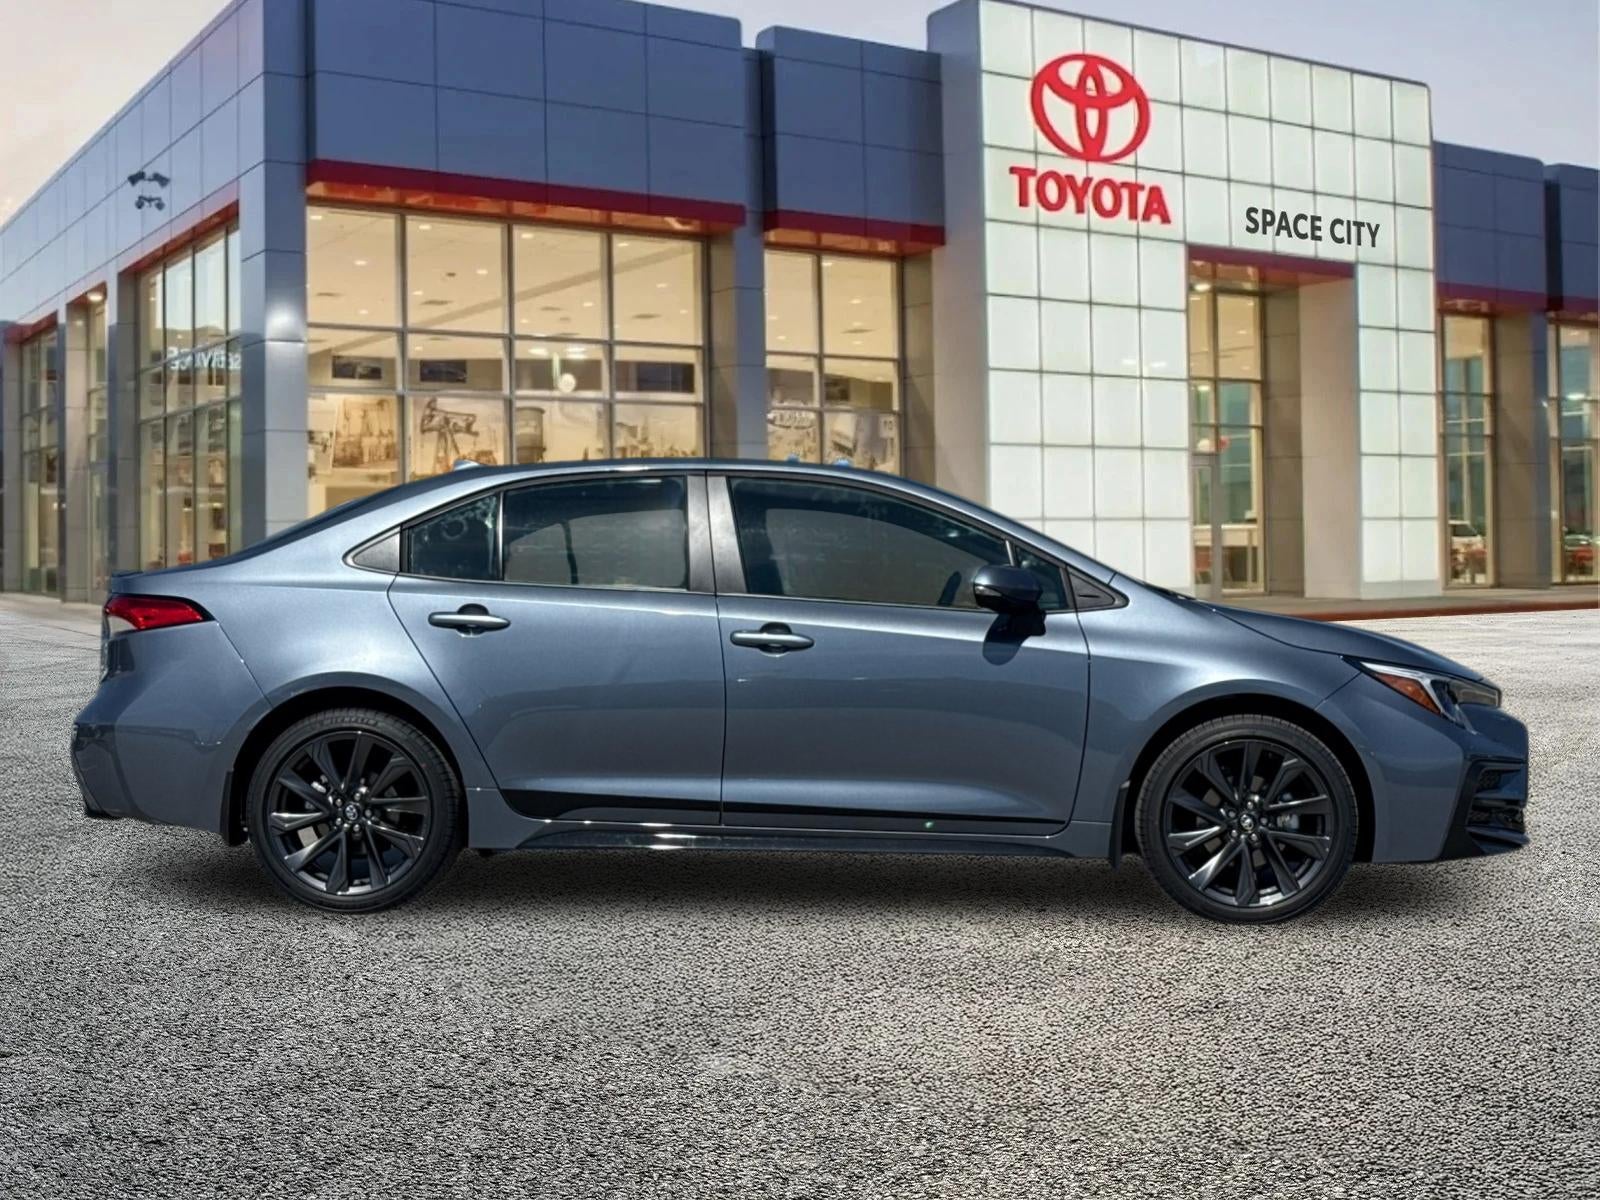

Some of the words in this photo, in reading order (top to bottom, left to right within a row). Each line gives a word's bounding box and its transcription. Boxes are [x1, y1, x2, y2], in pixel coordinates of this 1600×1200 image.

[1009, 166, 1171, 224] TOYOTA
[1245, 206, 1323, 242] SPACE
[1329, 218, 1380, 248] CITY
